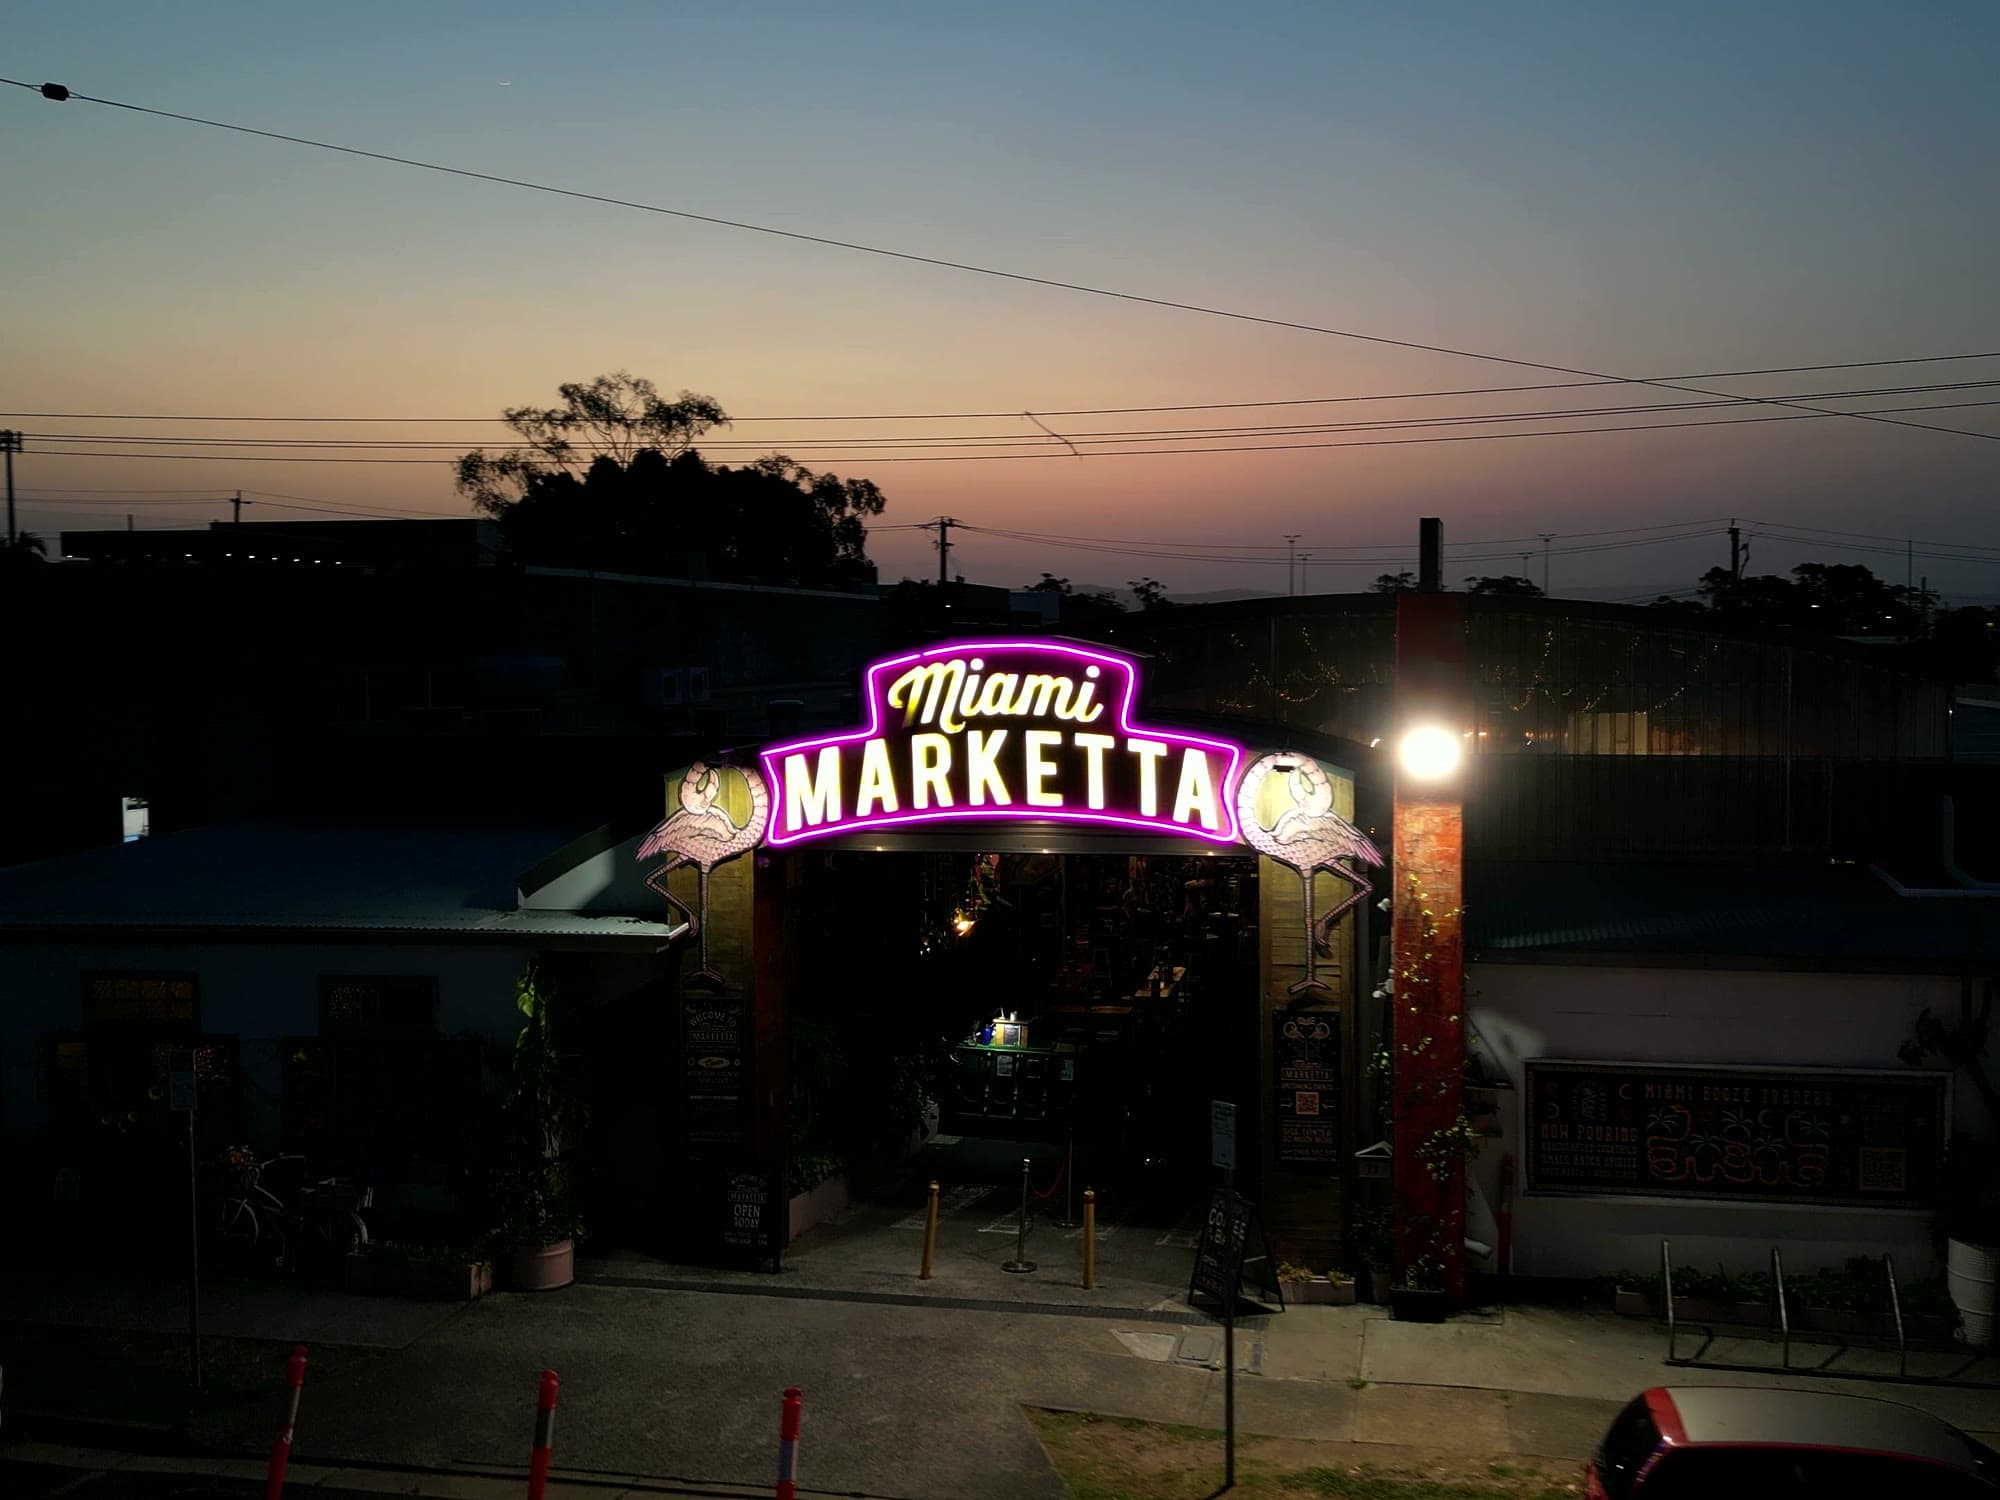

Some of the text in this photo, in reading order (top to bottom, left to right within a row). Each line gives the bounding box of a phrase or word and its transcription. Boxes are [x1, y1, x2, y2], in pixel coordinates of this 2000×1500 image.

[888, 657, 1103, 733] Miami
[785, 730, 1218, 831] MARKETTA
[1644, 1083, 1694, 1101] MIAMI
[1703, 1086, 1752, 1104] BOOZE
[1541, 1123, 1638, 1142] NOW POURING
[734, 1204, 760, 1218] OPEN
[734, 1216, 760, 1229] TODAY
